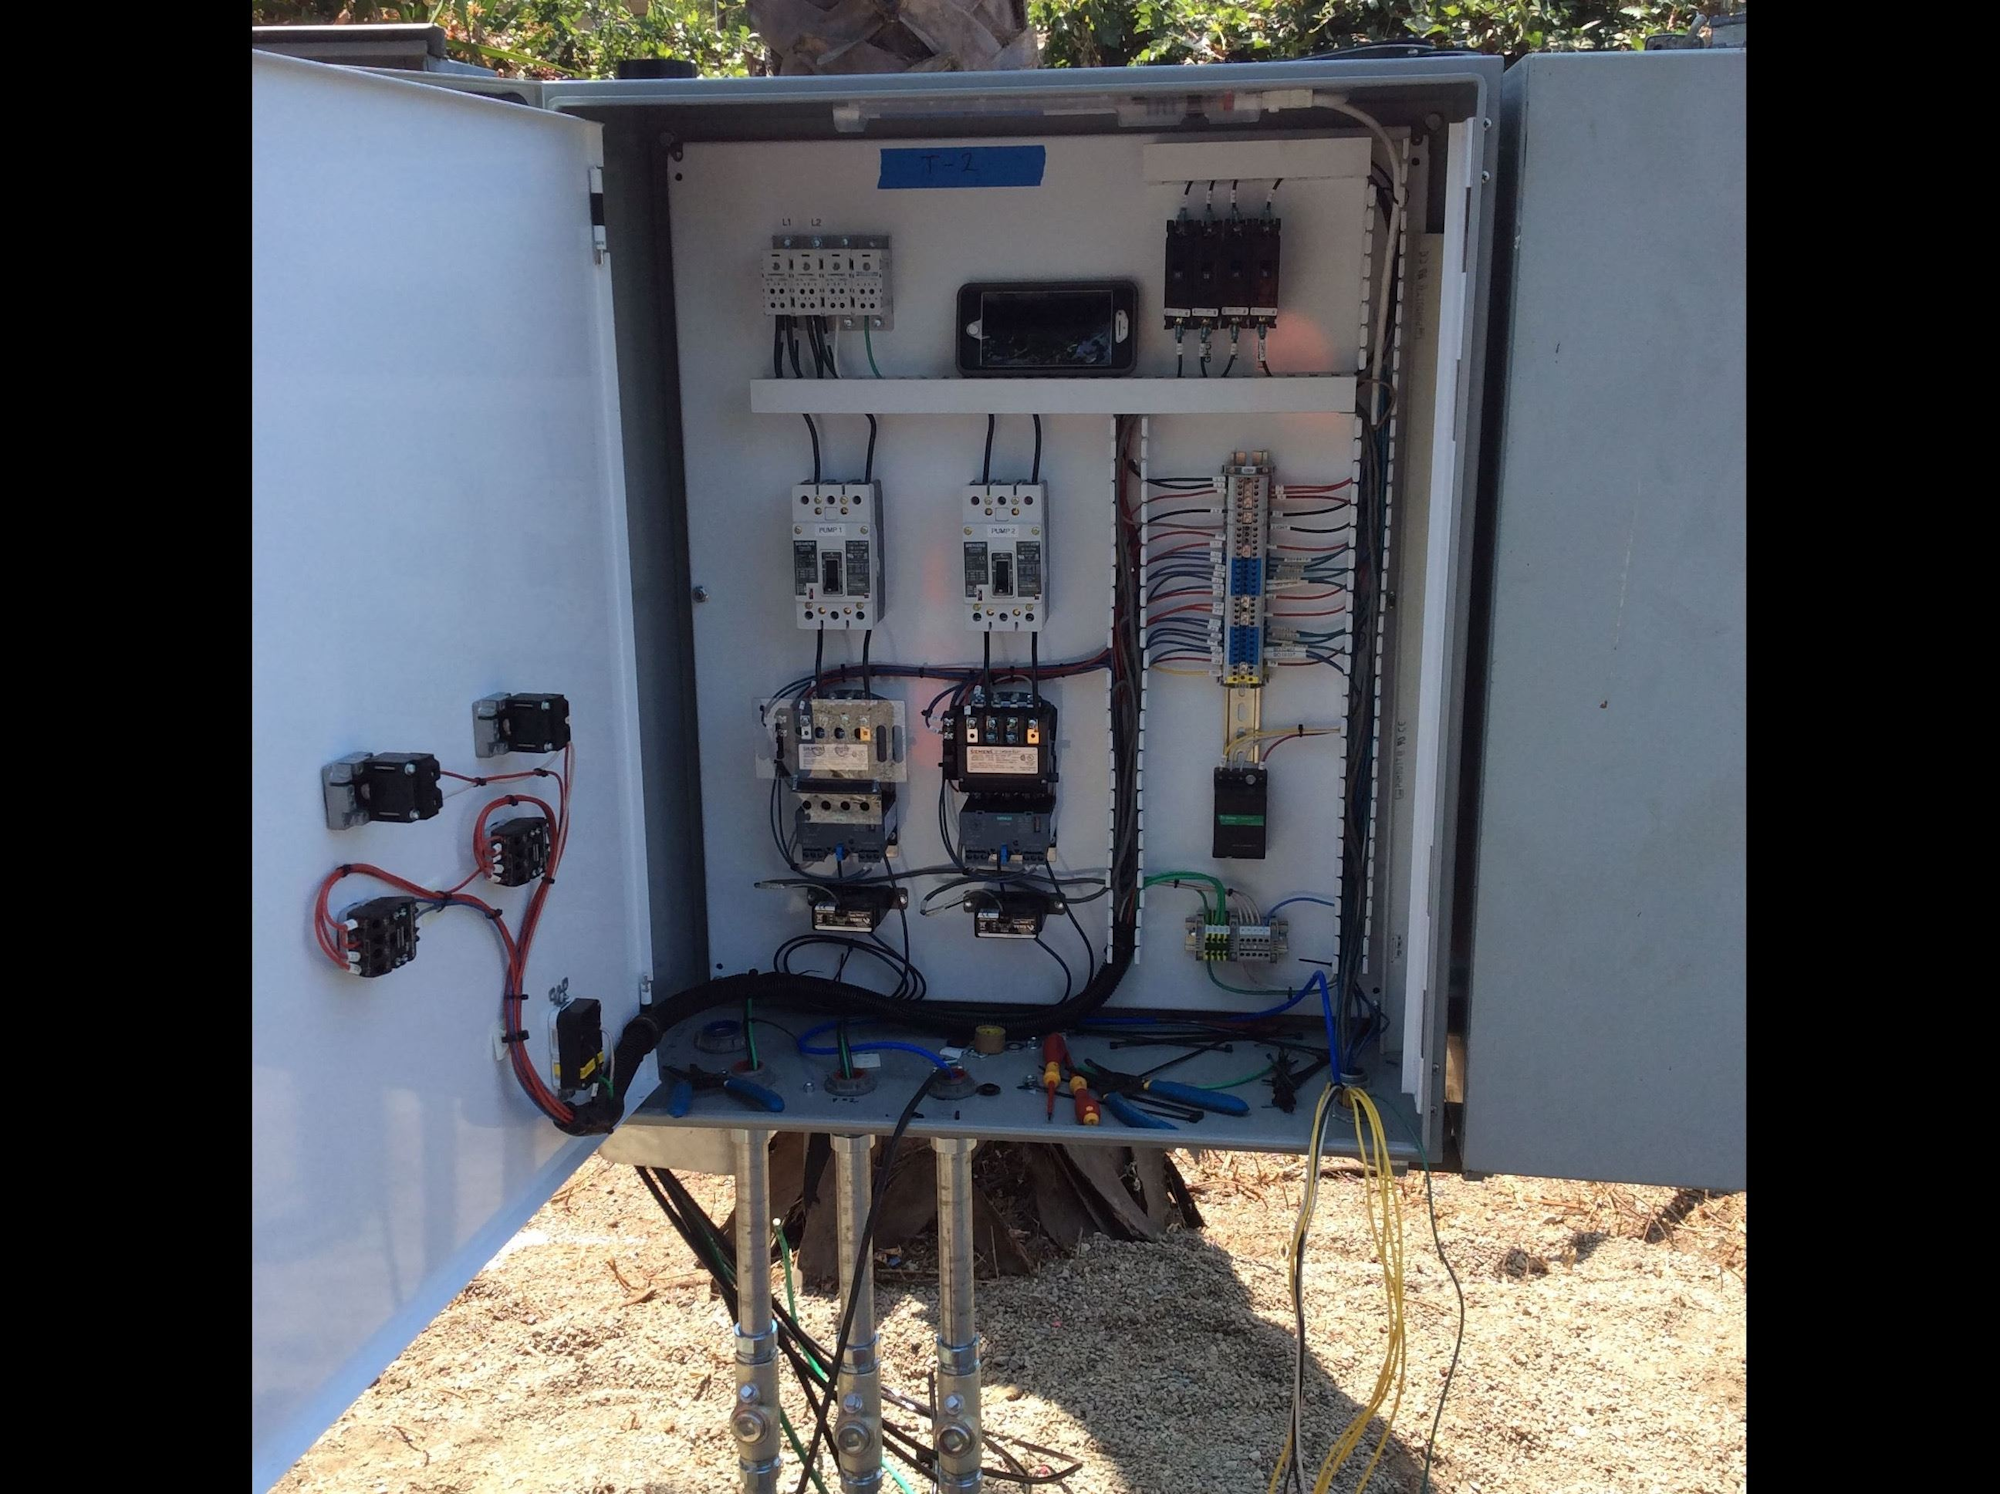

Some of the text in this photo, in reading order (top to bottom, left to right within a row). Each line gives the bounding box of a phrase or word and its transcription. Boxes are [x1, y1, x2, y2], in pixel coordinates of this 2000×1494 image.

[921, 153, 979, 174] T-2
[782, 218, 791, 227] L1
[811, 218, 821, 227] L2
